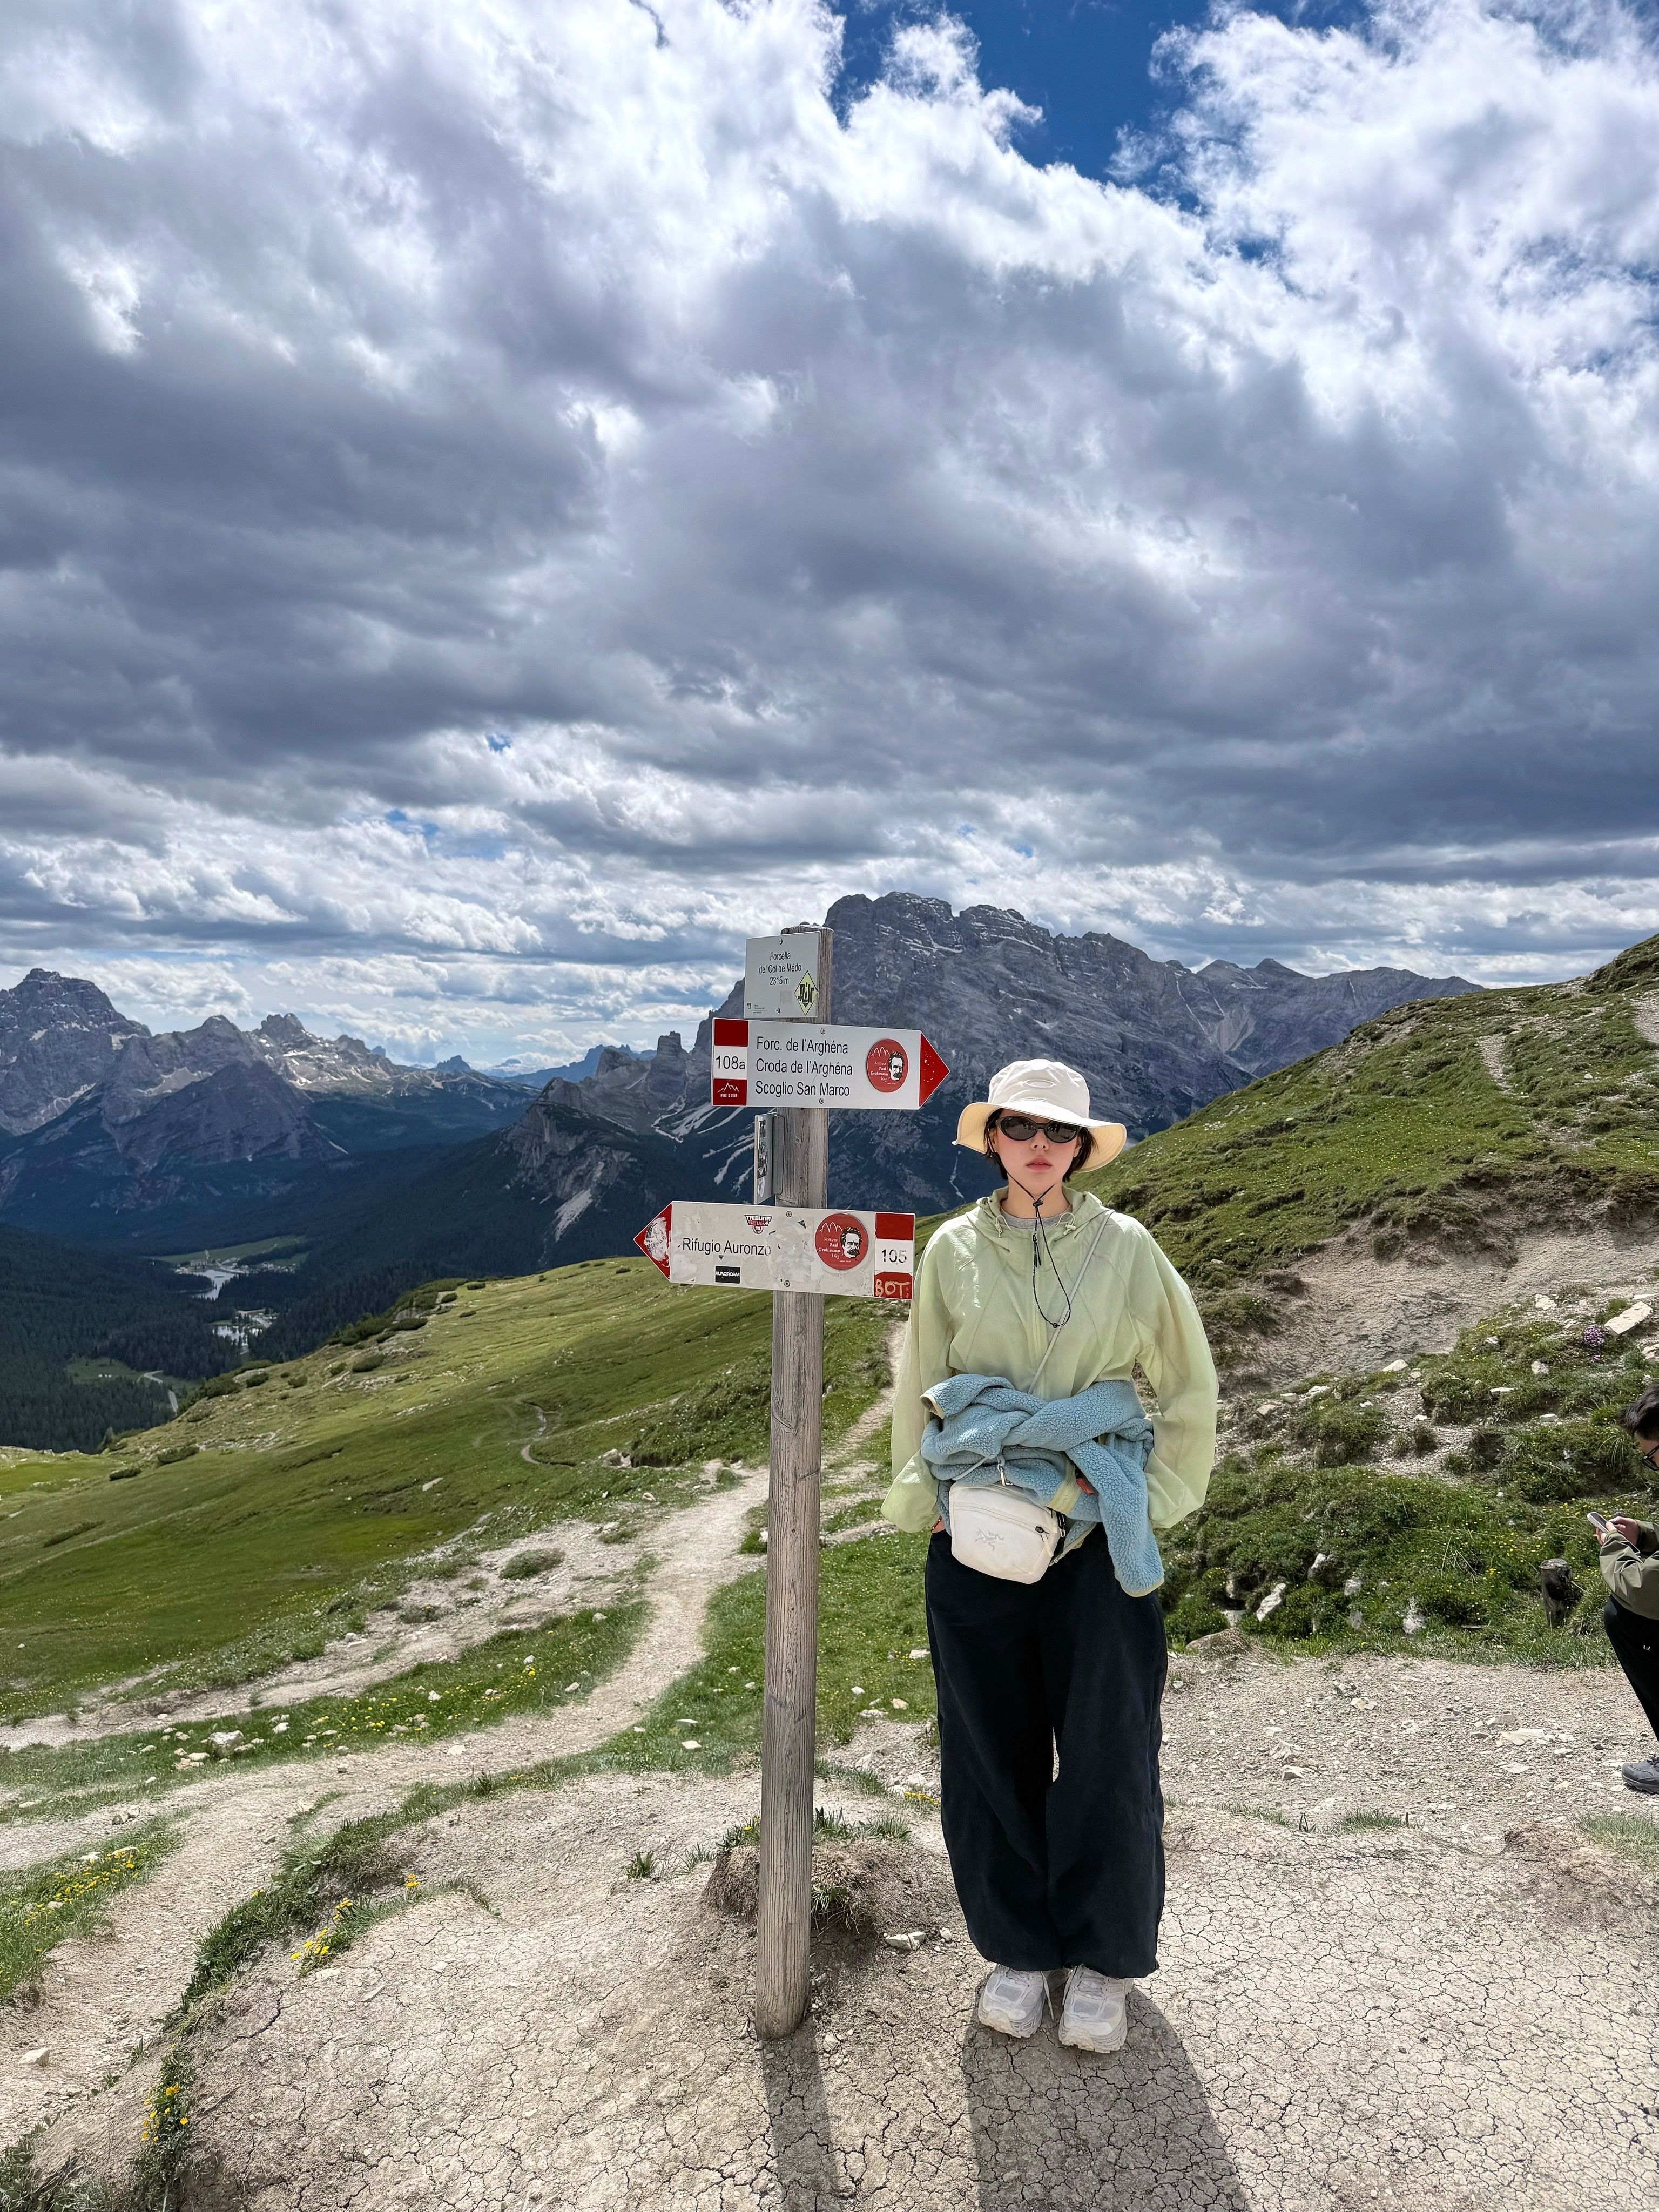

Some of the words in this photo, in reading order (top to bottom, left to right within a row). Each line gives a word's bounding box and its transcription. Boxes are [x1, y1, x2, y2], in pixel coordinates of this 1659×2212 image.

[770, 951, 791, 960] Forcella
[759, 965, 767, 974] del
[768, 964, 777, 973] Col
[778, 964, 785, 972] de
[770, 976, 783, 985] 2315
[757, 1036, 783, 1050] Forc.
[786, 1037, 798, 1051] de
[802, 1038, 848, 1056] l'Arghéna
[716, 1055, 745, 1070] 108a
[756, 1058, 787, 1073] Croda
[791, 1060, 803, 1074] de
[806, 1060, 852, 1078] l'Arghéna
[756, 1080, 793, 1098] Scoglio
[797, 1081, 816, 1095] San
[820, 1082, 850, 1096] Marco
[683, 1237, 721, 1255] Rifugio
[881, 1249, 907, 1263] 105
